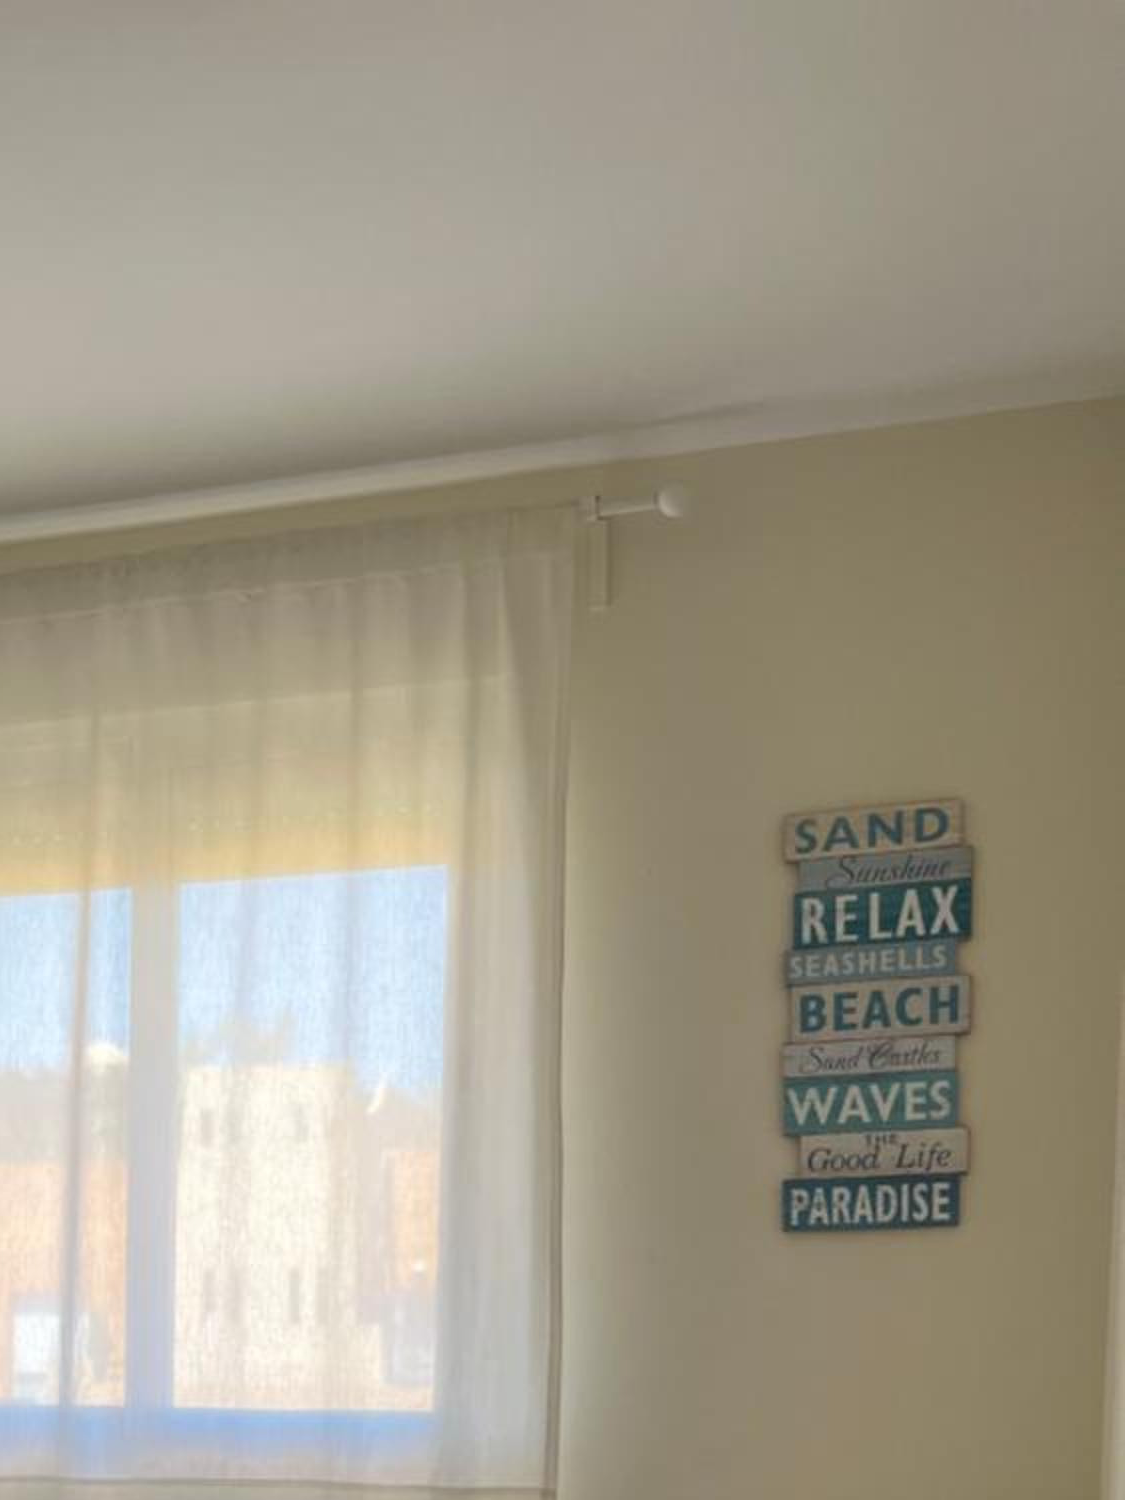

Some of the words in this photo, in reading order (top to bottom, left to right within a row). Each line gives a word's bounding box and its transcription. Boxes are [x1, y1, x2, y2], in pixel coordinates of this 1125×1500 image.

[794, 806, 950, 854] SAND
[826, 853, 953, 887] Sunshine
[800, 884, 960, 945] RELAX
[788, 944, 948, 979] SEASHELLS
[799, 985, 960, 1033] BEACH
[799, 1045, 863, 1074] Sand
[785, 1079, 952, 1126] WAVES
[807, 1144, 881, 1174] Good
[894, 1142, 952, 1172] Life
[789, 1181, 952, 1227] PARADISE
